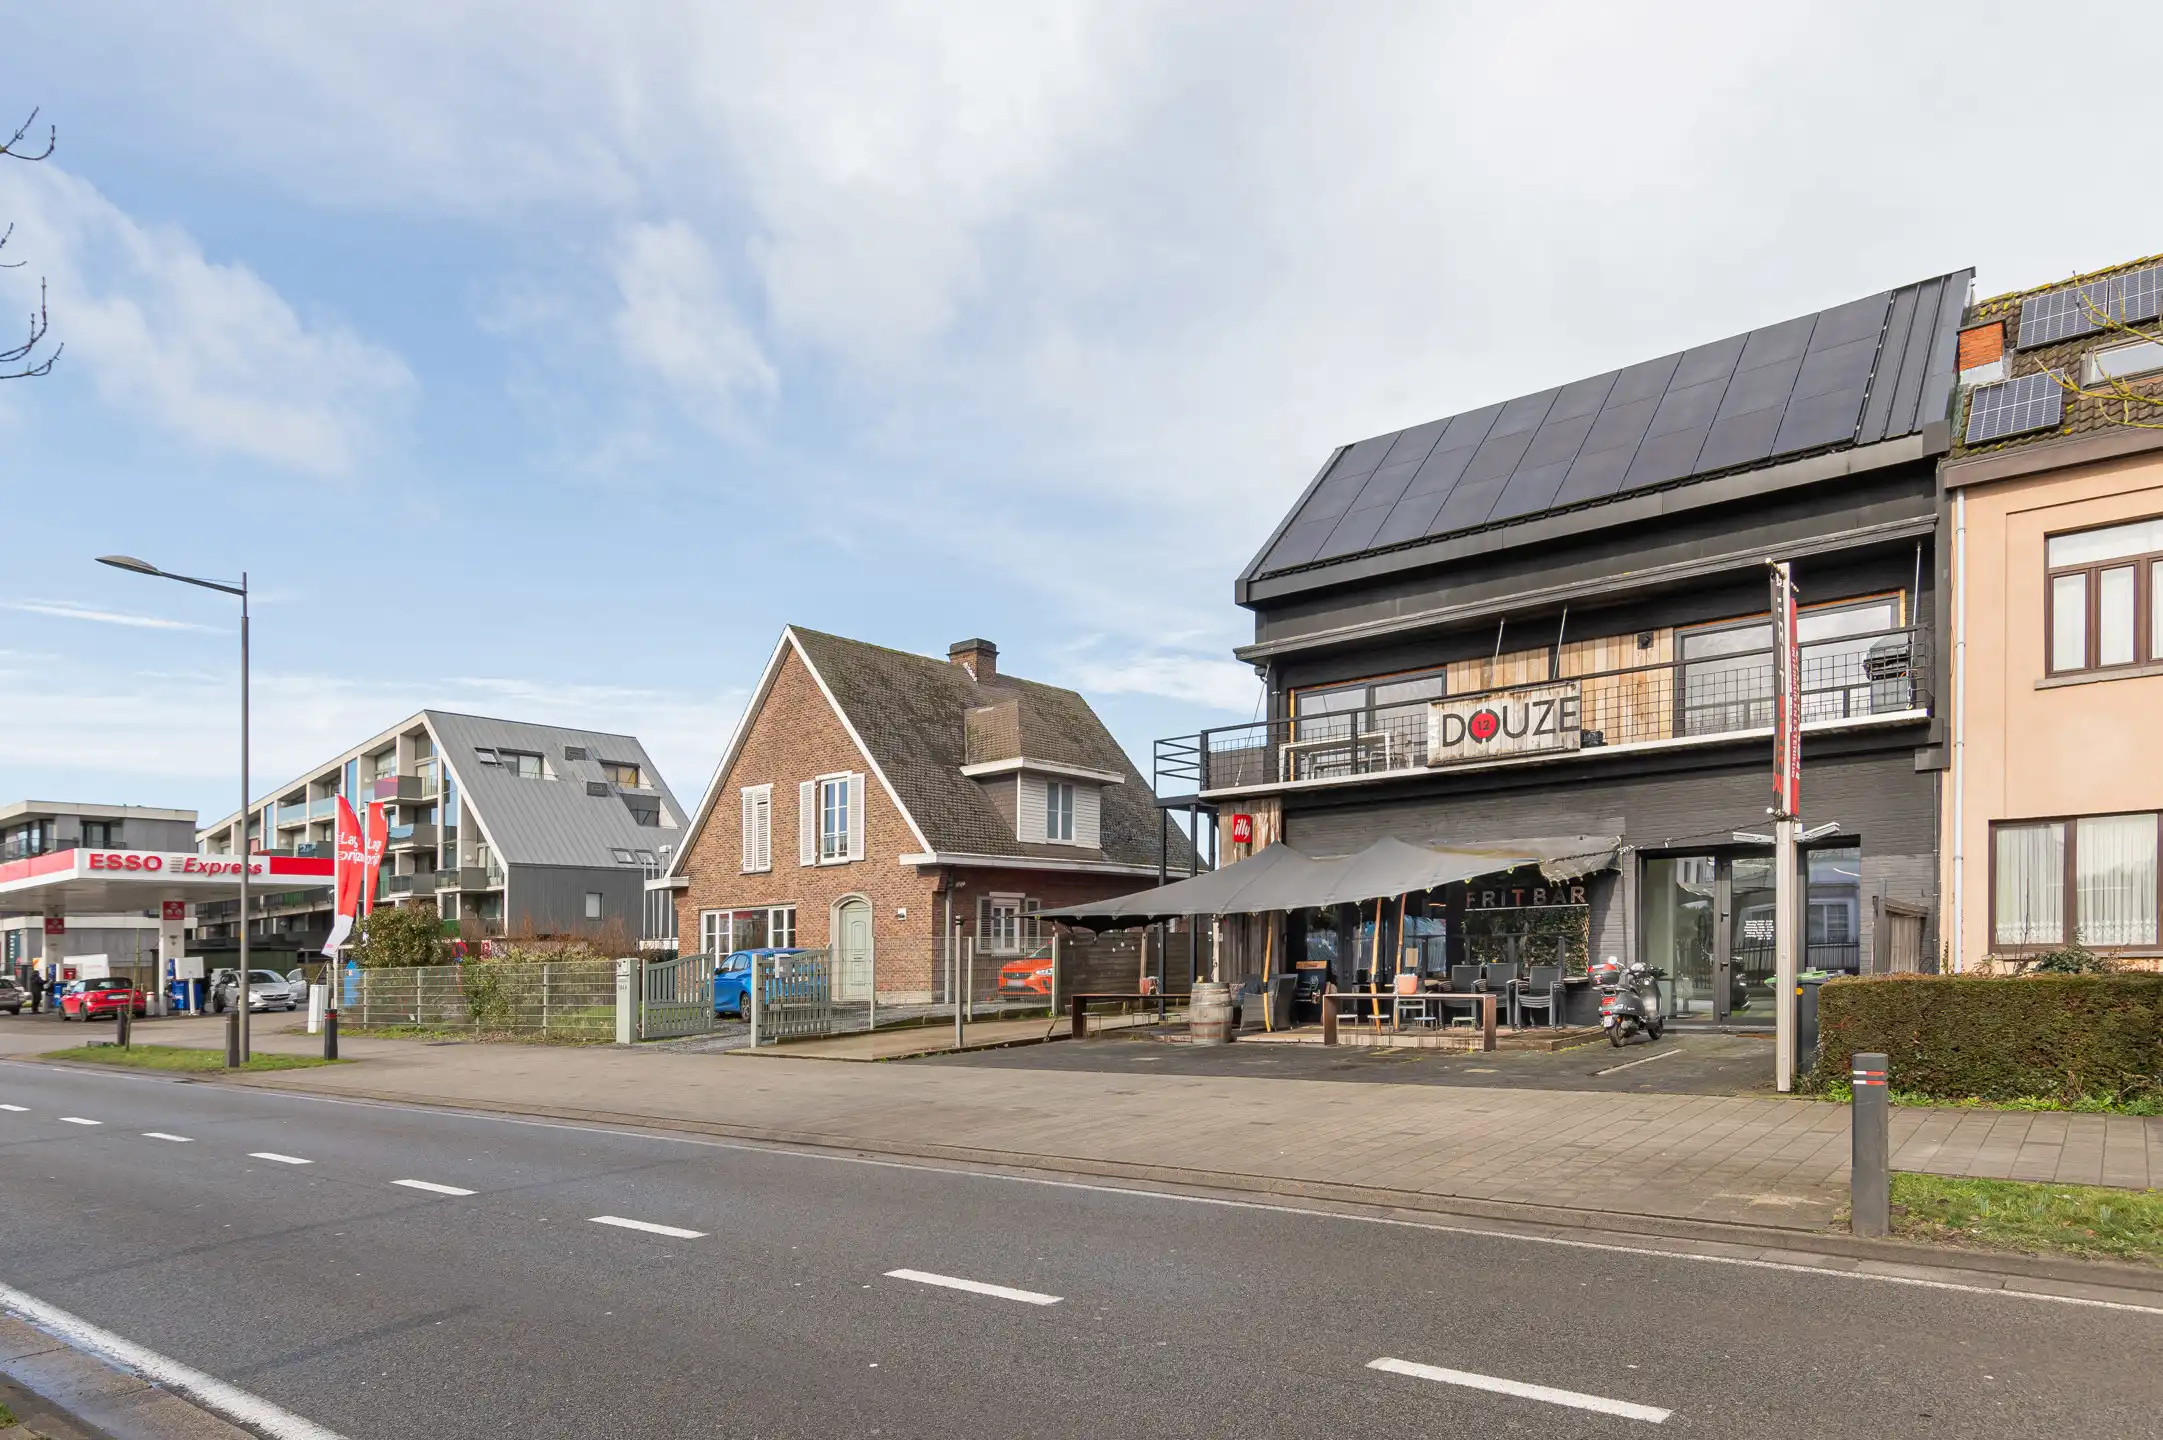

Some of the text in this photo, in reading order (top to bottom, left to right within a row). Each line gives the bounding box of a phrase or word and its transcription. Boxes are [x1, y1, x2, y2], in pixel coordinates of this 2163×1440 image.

[1442, 696, 1580, 748] DOUZE
[1477, 720, 1490, 731] 12
[1234, 818, 1251, 840] illy
[88, 853, 163, 872] ESSO
